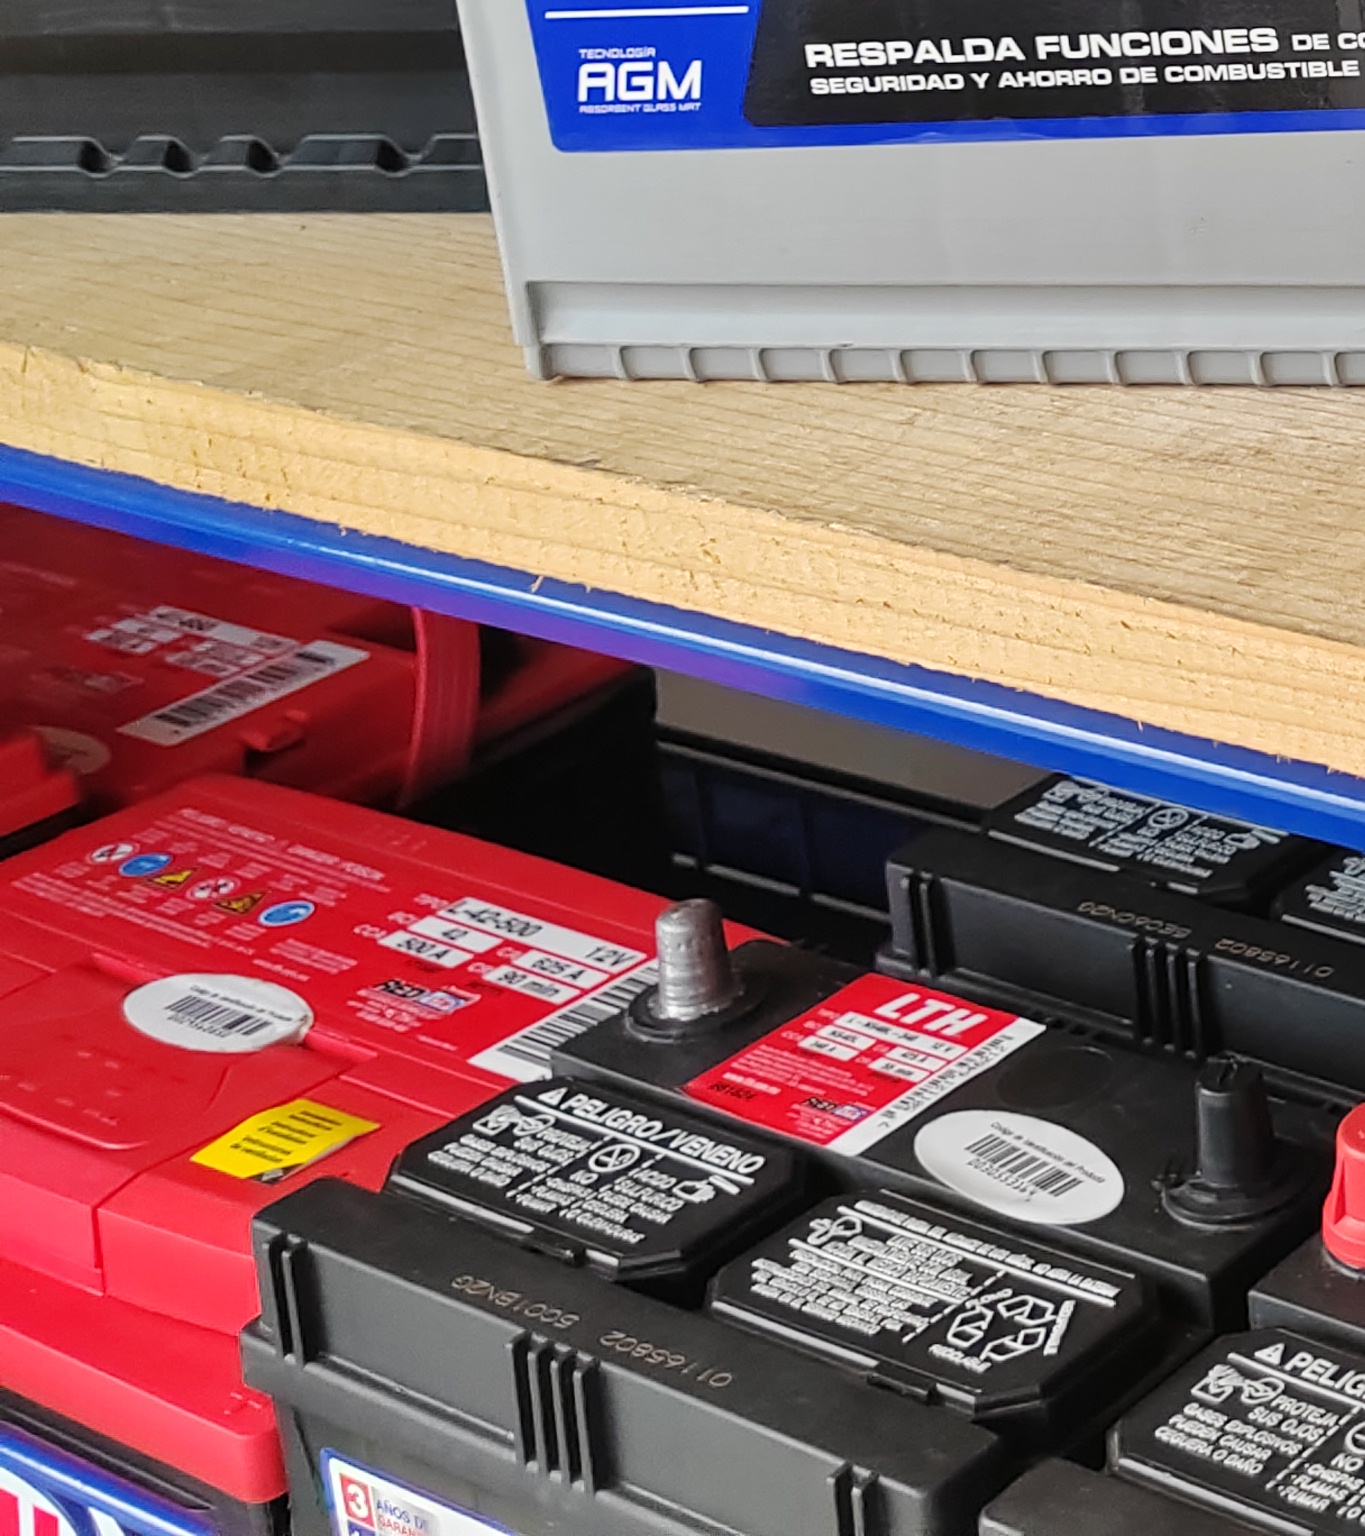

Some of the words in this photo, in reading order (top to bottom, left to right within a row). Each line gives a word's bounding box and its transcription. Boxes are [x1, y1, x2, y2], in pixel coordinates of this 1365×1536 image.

[804, 36, 1026, 68] RESPALDA
[1036, 28, 1279, 62] FUNCIONES
[1292, 33, 1328, 51] DE
[578, 60, 702, 102] AGM
[811, 73, 964, 95] SEGURIDAD
[971, 71, 991, 88] Y
[998, 68, 1112, 88] AHORRO
[1120, 66, 1157, 84] DE
[1164, 60, 1359, 82] COMBUSTIBLE
[873, 993, 988, 1036] LTH
[1248, 1406, 1277, 1423] SUS
[1279, 1415, 1324, 1443] OJOS
[1270, 1395, 1339, 1427] PROTEJA
[1330, 1454, 1364, 1472] NO
[346, 1484, 368, 1518] 3
[377, 1499, 411, 1523] AÑOS
